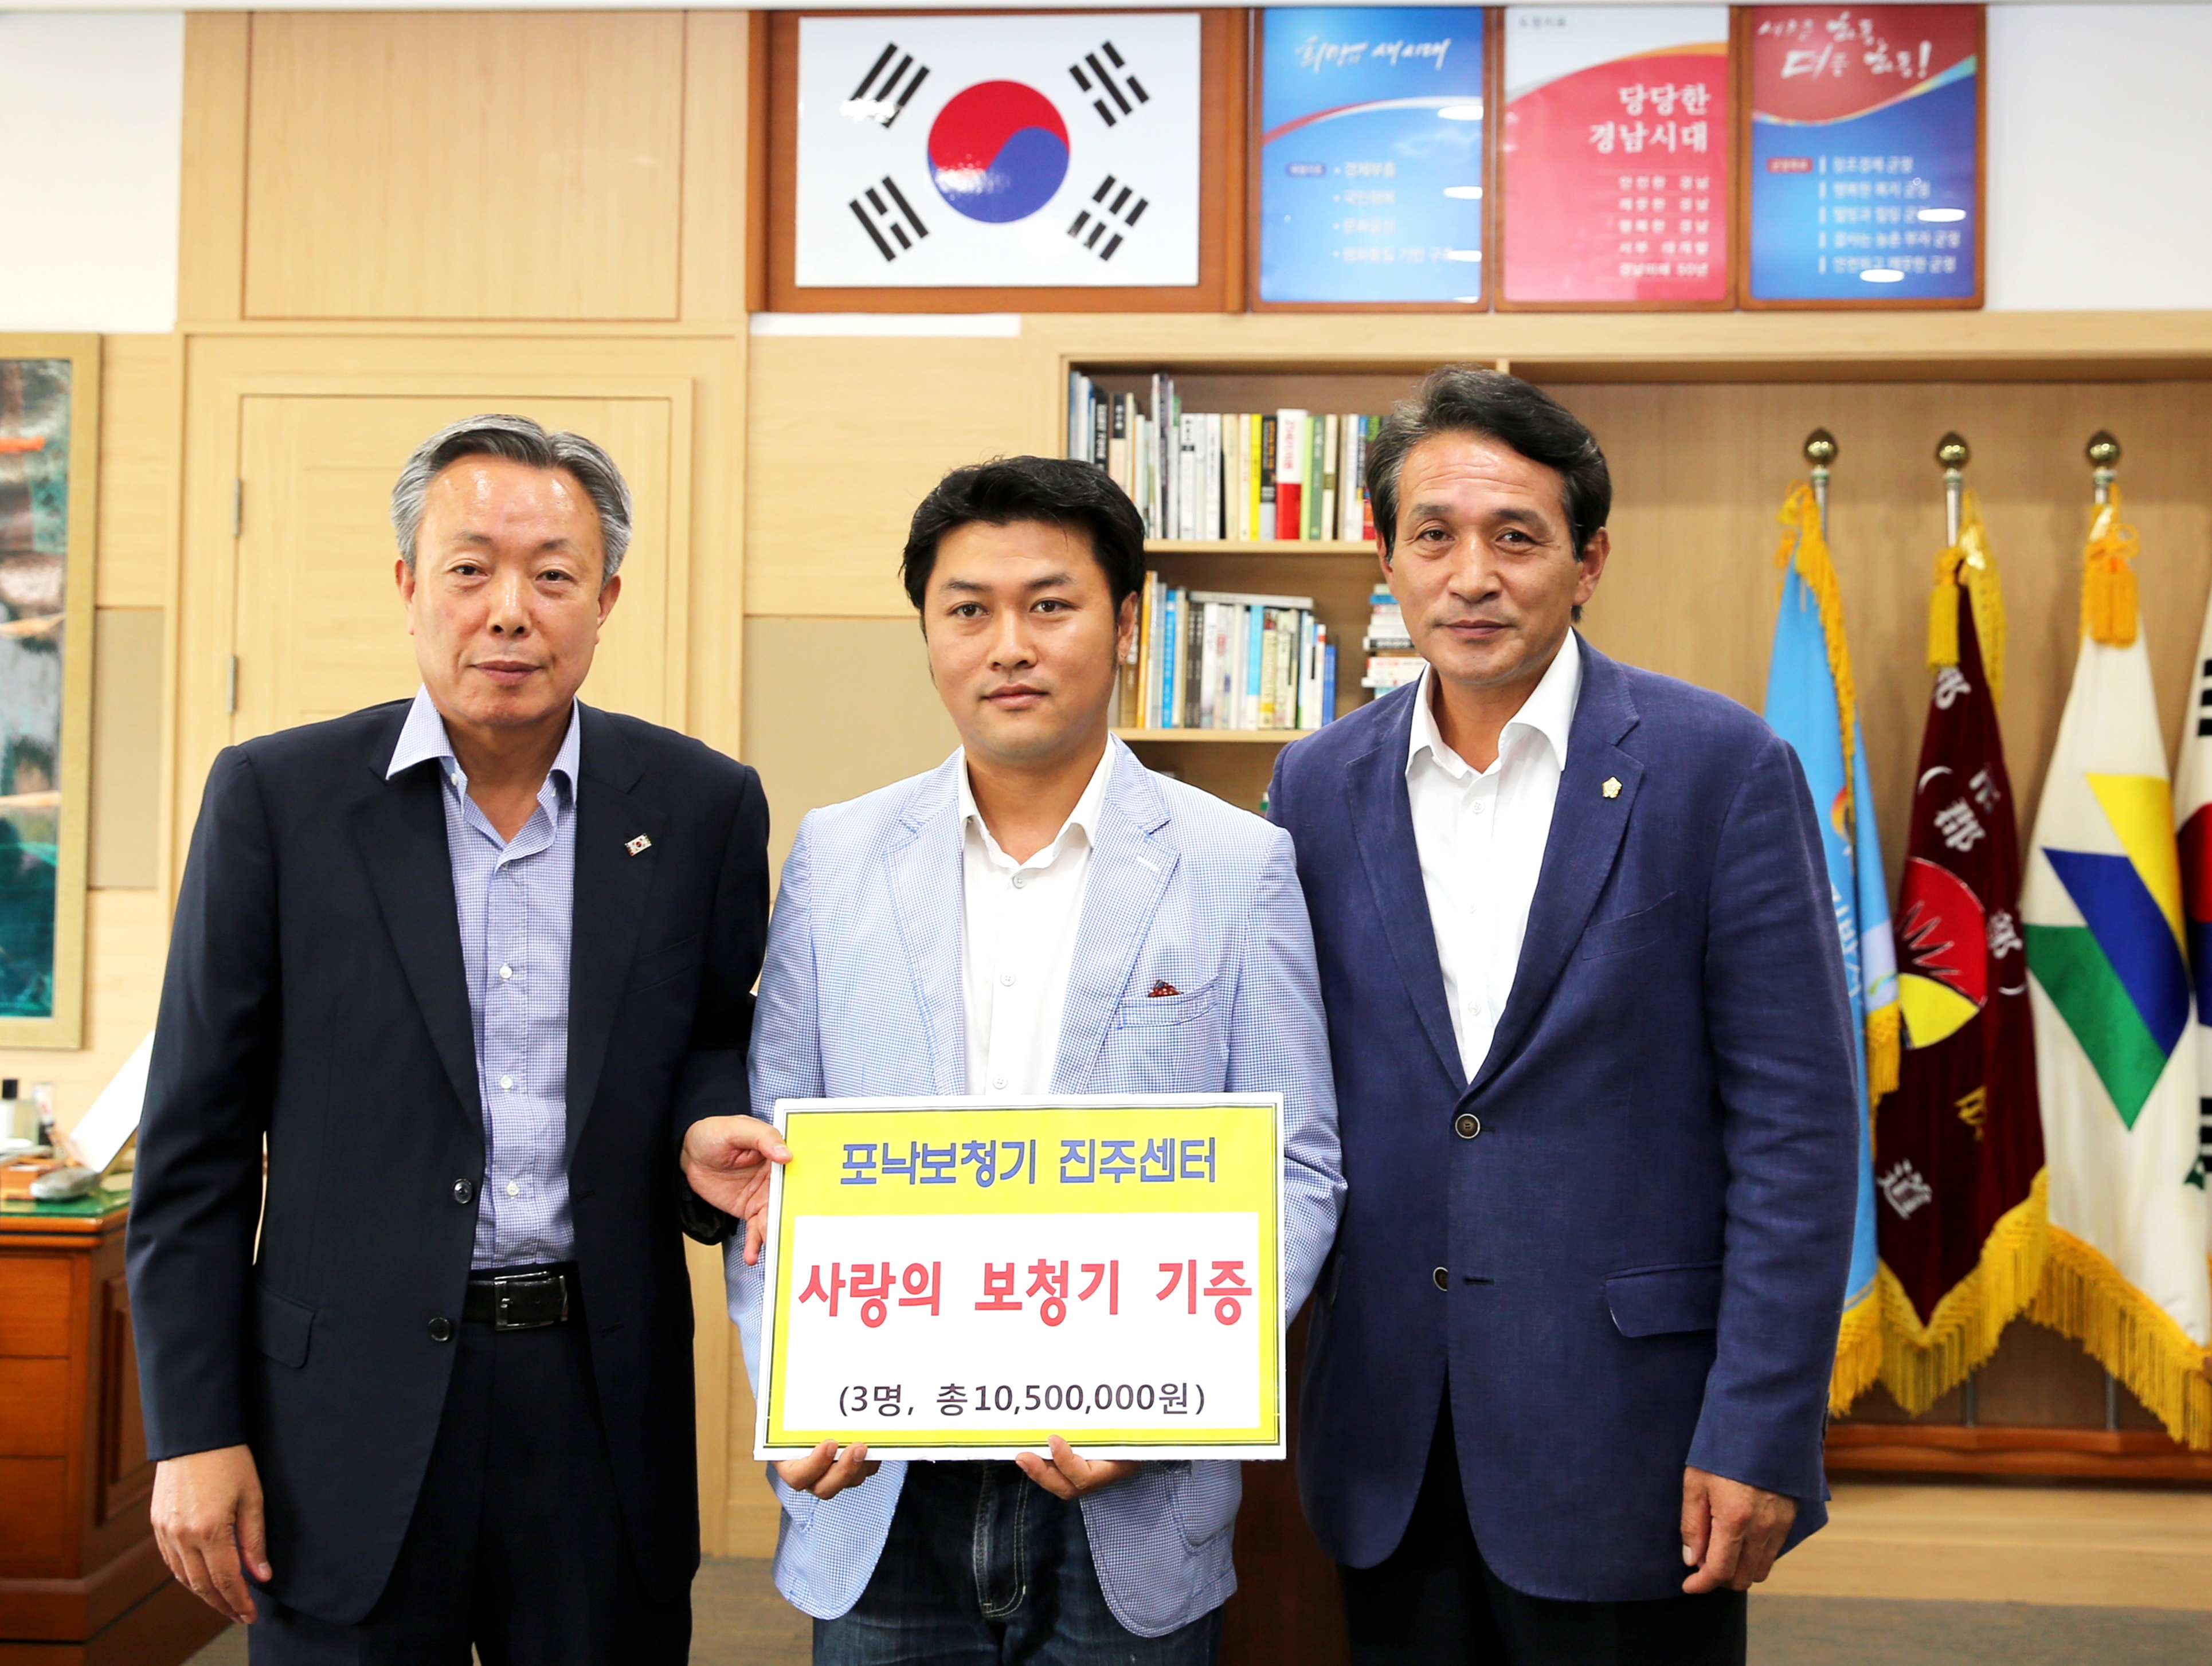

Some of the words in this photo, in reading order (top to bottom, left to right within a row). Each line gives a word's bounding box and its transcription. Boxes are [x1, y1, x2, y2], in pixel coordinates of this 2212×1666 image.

[1618, 83, 1711, 116] 당당한
[1588, 120, 1708, 154] 경남시대
[840, 1139, 1036, 1187] 포낙보청기
[1060, 1137, 1216, 1183] 진주센터
[798, 1261, 942, 1328] 사랑의
[974, 1258, 1119, 1327] 보청기
[1156, 1259, 1252, 1326] 기증
[839, 1383, 914, 1417] (3명,
